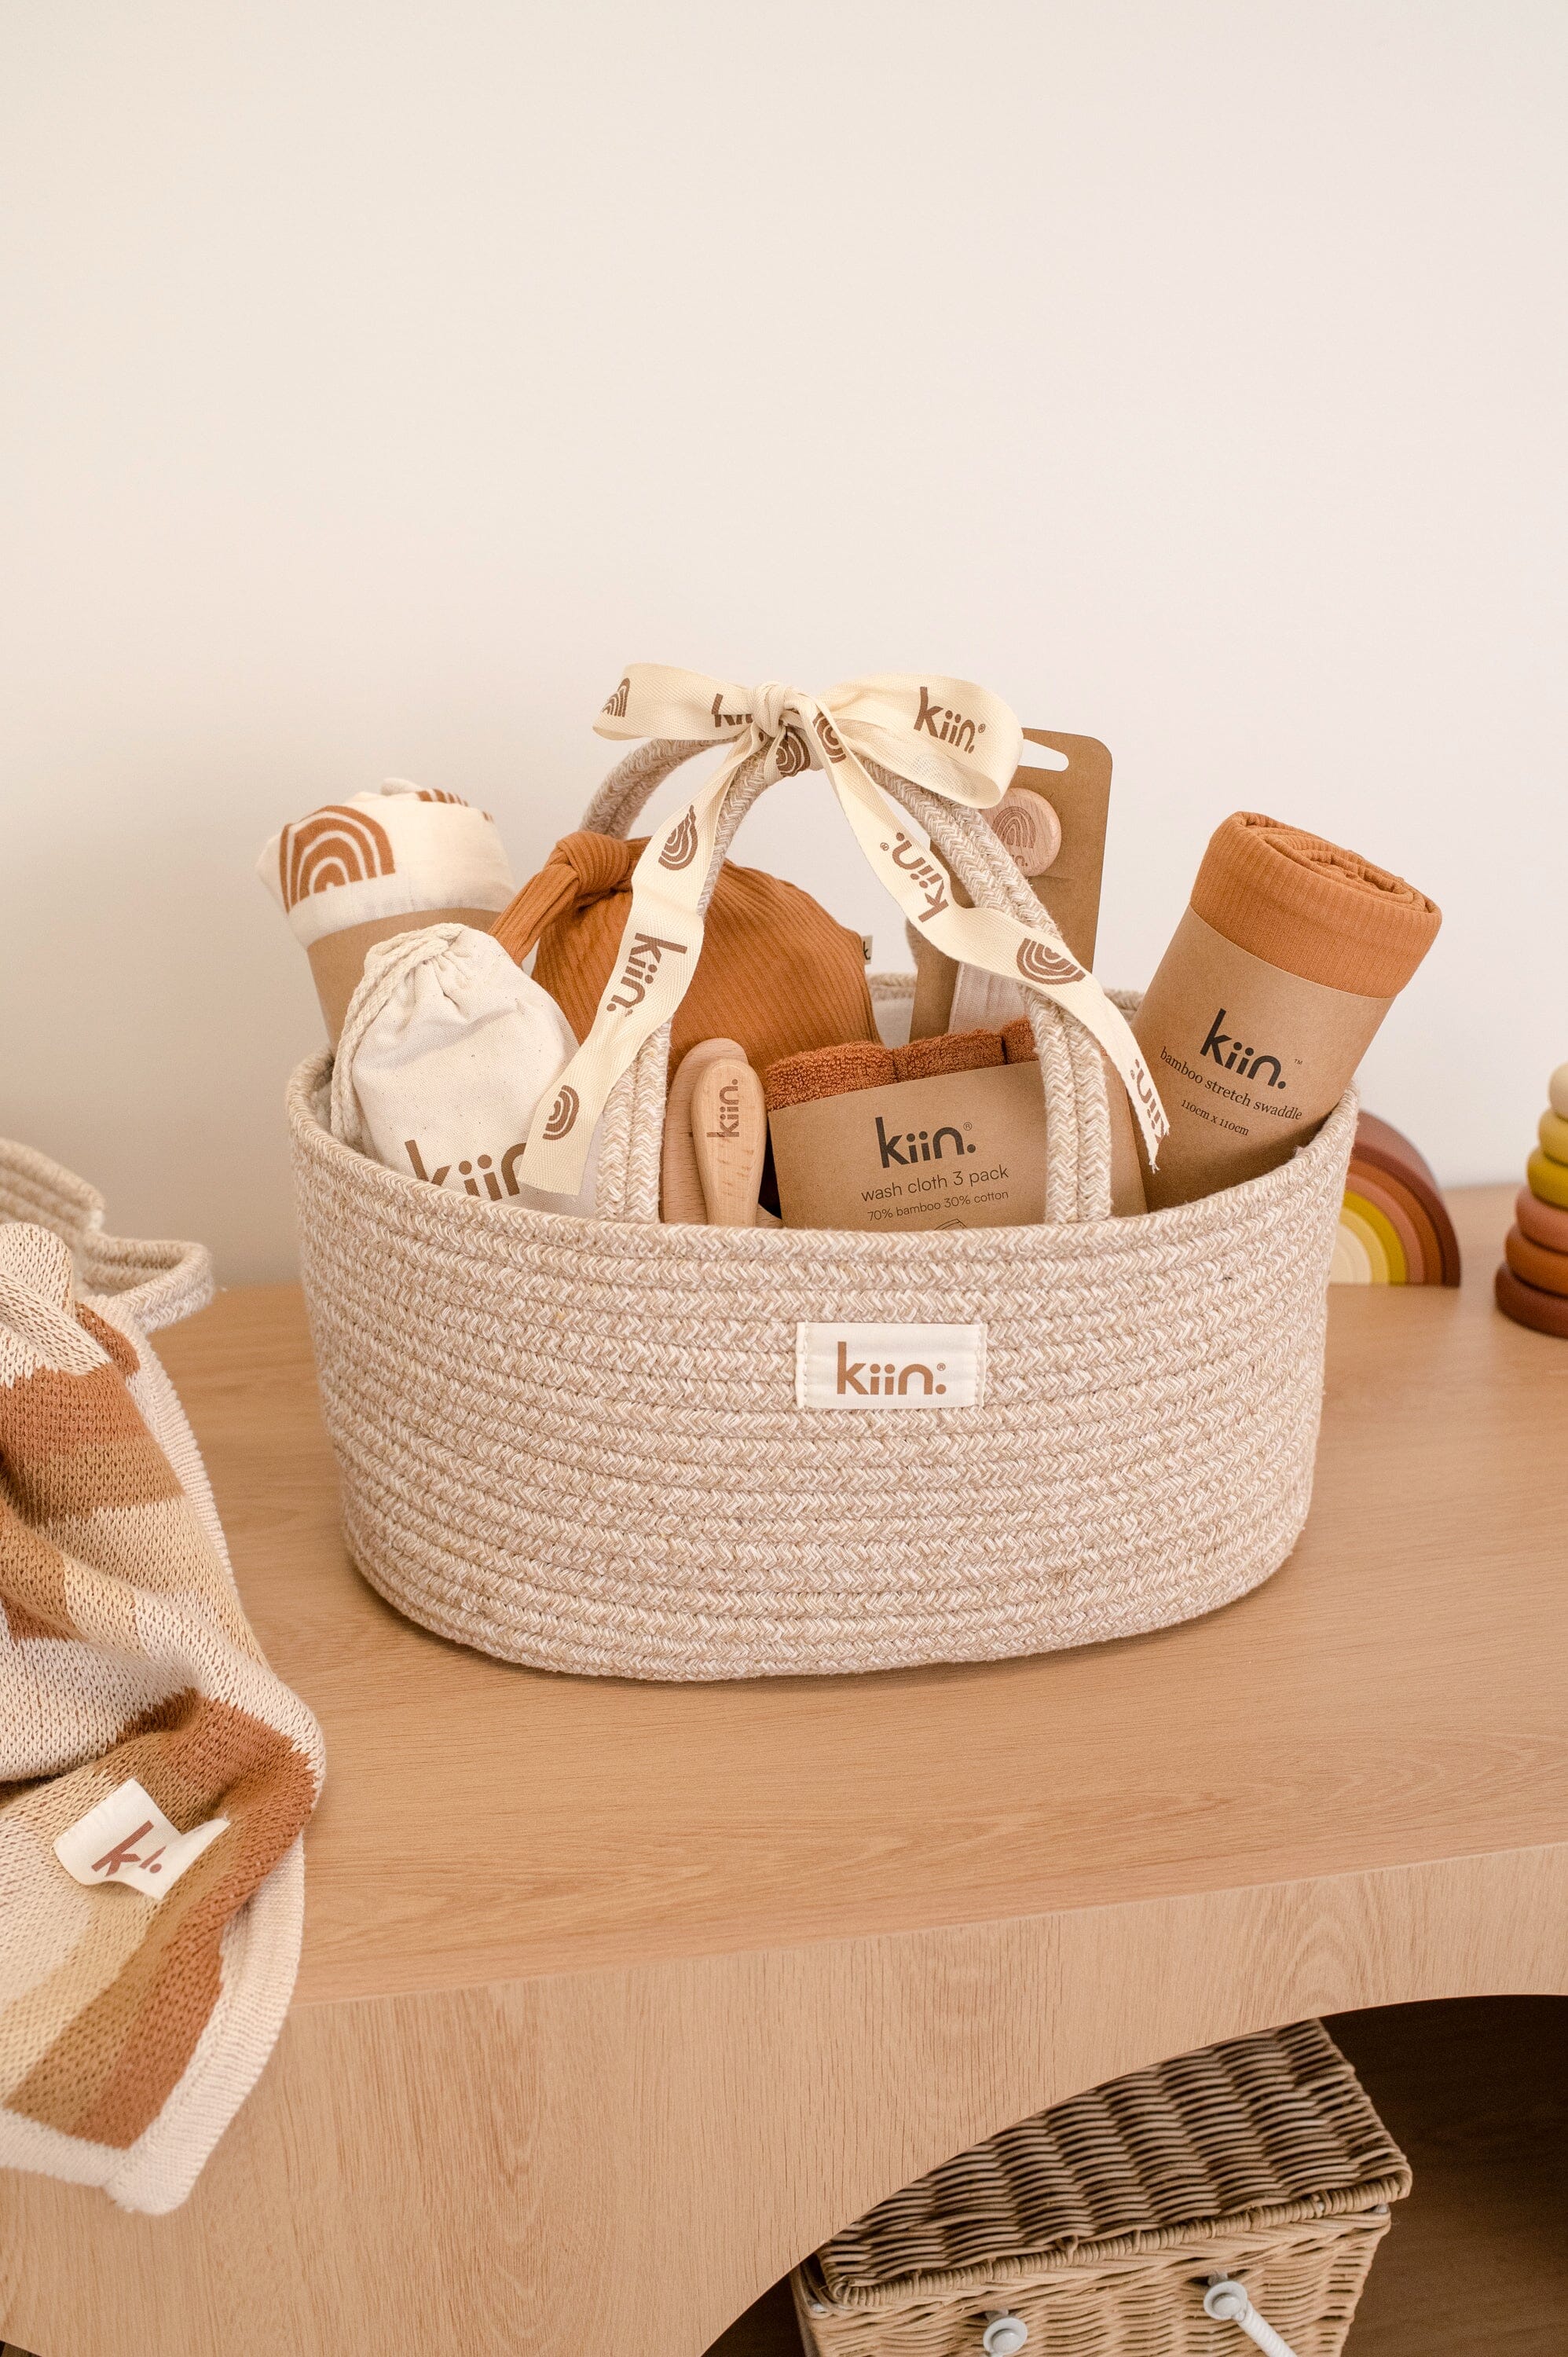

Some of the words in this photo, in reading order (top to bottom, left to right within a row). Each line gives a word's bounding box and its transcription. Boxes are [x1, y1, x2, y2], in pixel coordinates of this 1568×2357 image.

[1160, 1046, 1203, 1084] bamboo
[1204, 1079, 1251, 1107] stretch
[1253, 1101, 1302, 1120] swaddle
[1181, 1099, 1211, 1120] 110cm
[1210, 1115, 1218, 1124] x
[1218, 1118, 1250, 1136] 110cm
[861, 1182, 903, 1202] wash
[907, 1174, 947, 1194] cloth
[953, 1171, 963, 1186] 3
[969, 1164, 1009, 1187] pack
[867, 1208, 893, 1221] 70%
[896, 1202, 941, 1216] bamboo
[943, 1195, 971, 1208] 30%
[974, 1190, 1009, 1204] cotton
